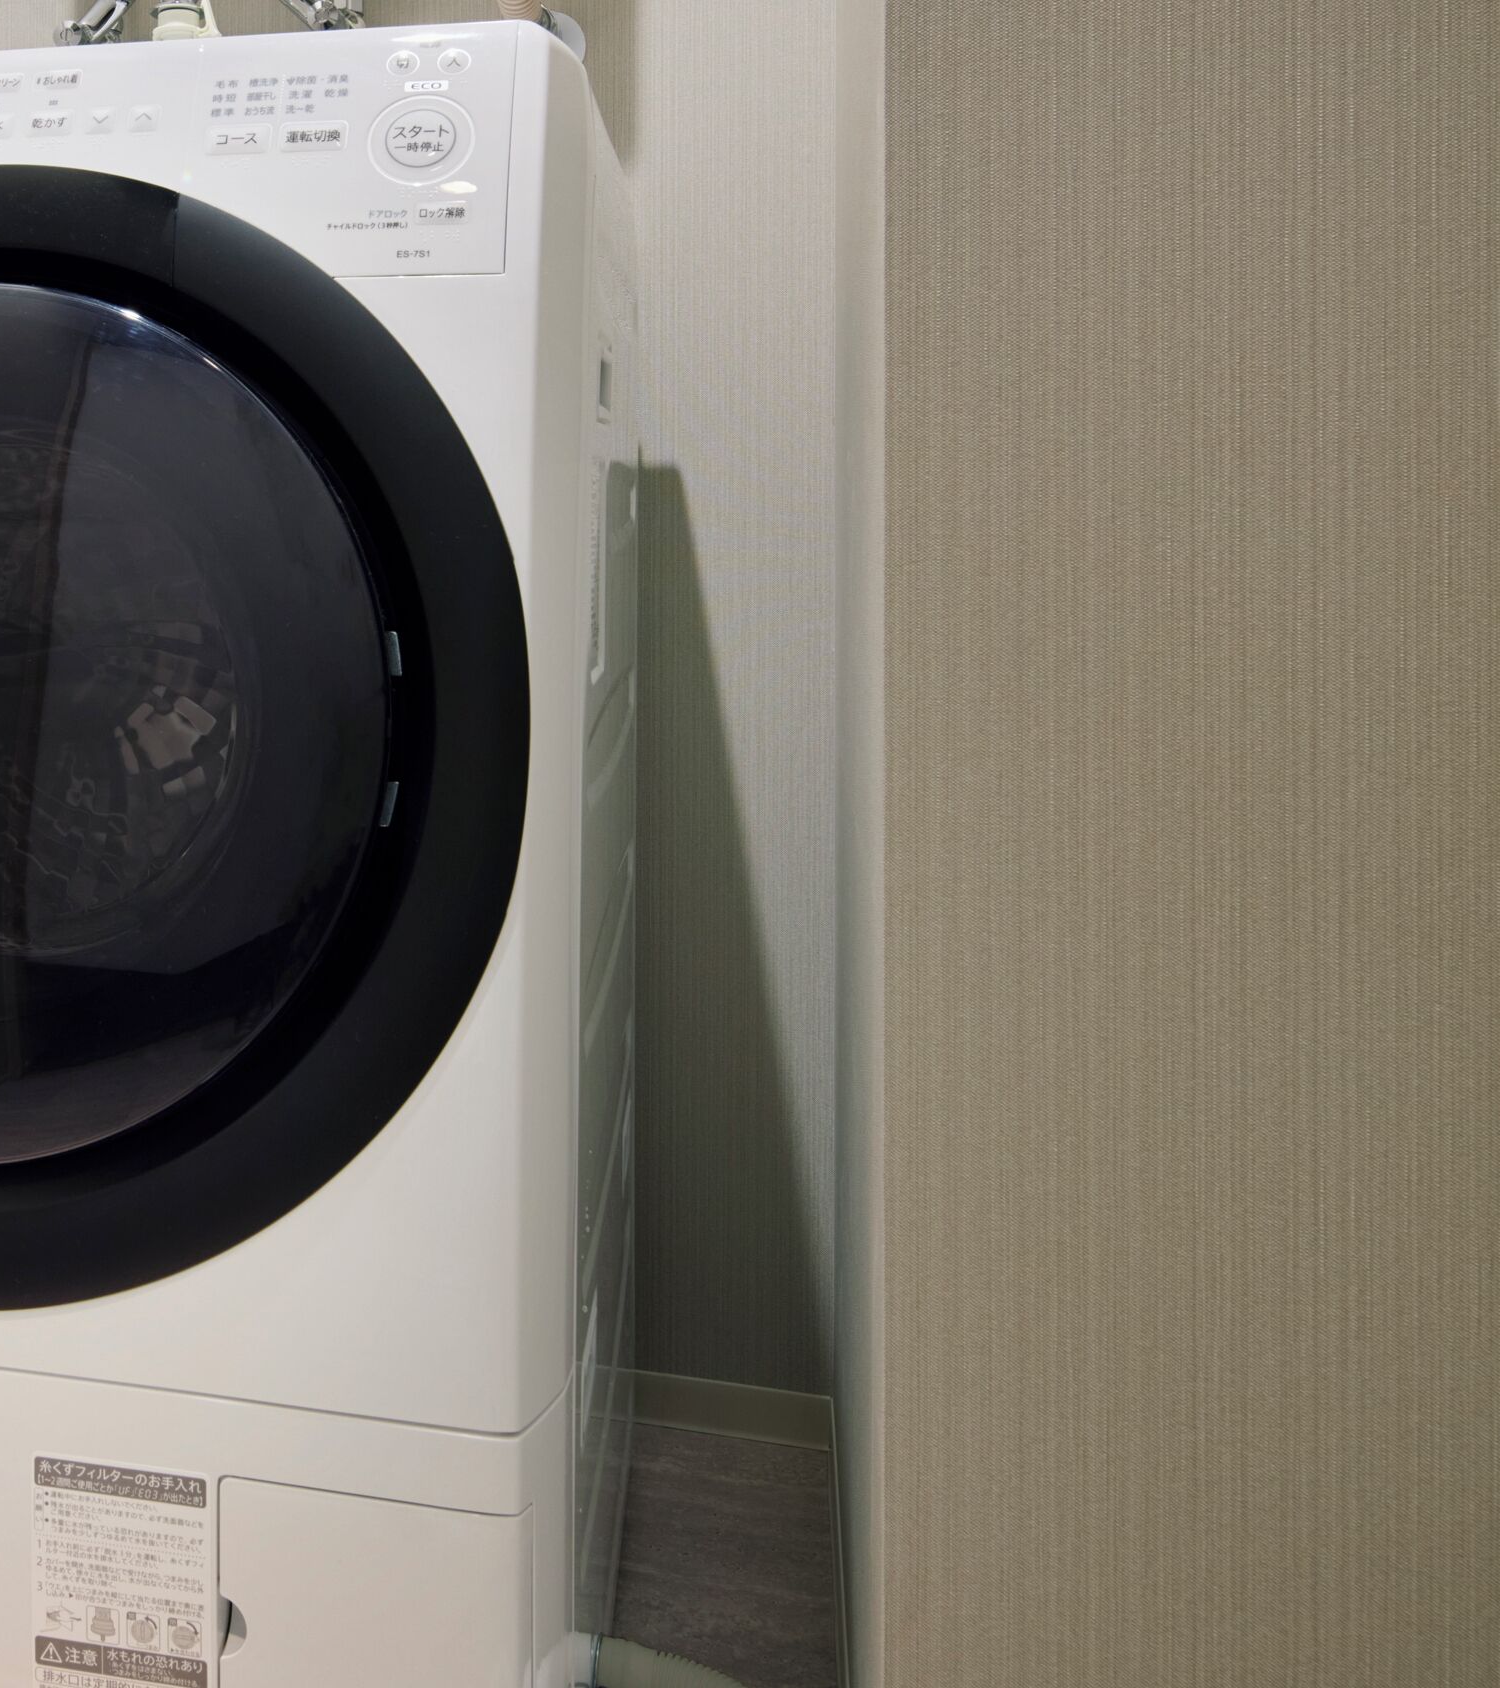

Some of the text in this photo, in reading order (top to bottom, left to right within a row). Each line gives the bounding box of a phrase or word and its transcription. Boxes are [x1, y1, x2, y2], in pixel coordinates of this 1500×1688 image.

[42, 74, 78, 86] おしゃれ着
[411, 82, 442, 90] ECO
[212, 93, 237, 103] 時短
[247, 91, 276, 102] 部屋干し
[210, 107, 235, 118] 標準
[244, 106, 276, 117] おうち流
[32, 117, 67, 129] 乾かす
[285, 129, 341, 144] 運転切換
[392, 124, 450, 140] スタート
[215, 132, 258, 145] コース
[394, 142, 445, 153] 一時停止
[368, 209, 408, 219] ドアロック
[419, 206, 466, 219] ロック解除
[396, 250, 430, 258] ES-7S1
[39, 1459, 202, 1494] 糸くずフィルターのお手入れ
[36, 1556, 43, 1566] 2
[36, 1581, 43, 1591] 3
[64, 1647, 98, 1667] 注意
[106, 1649, 203, 1674] 水もれの恐れあり
